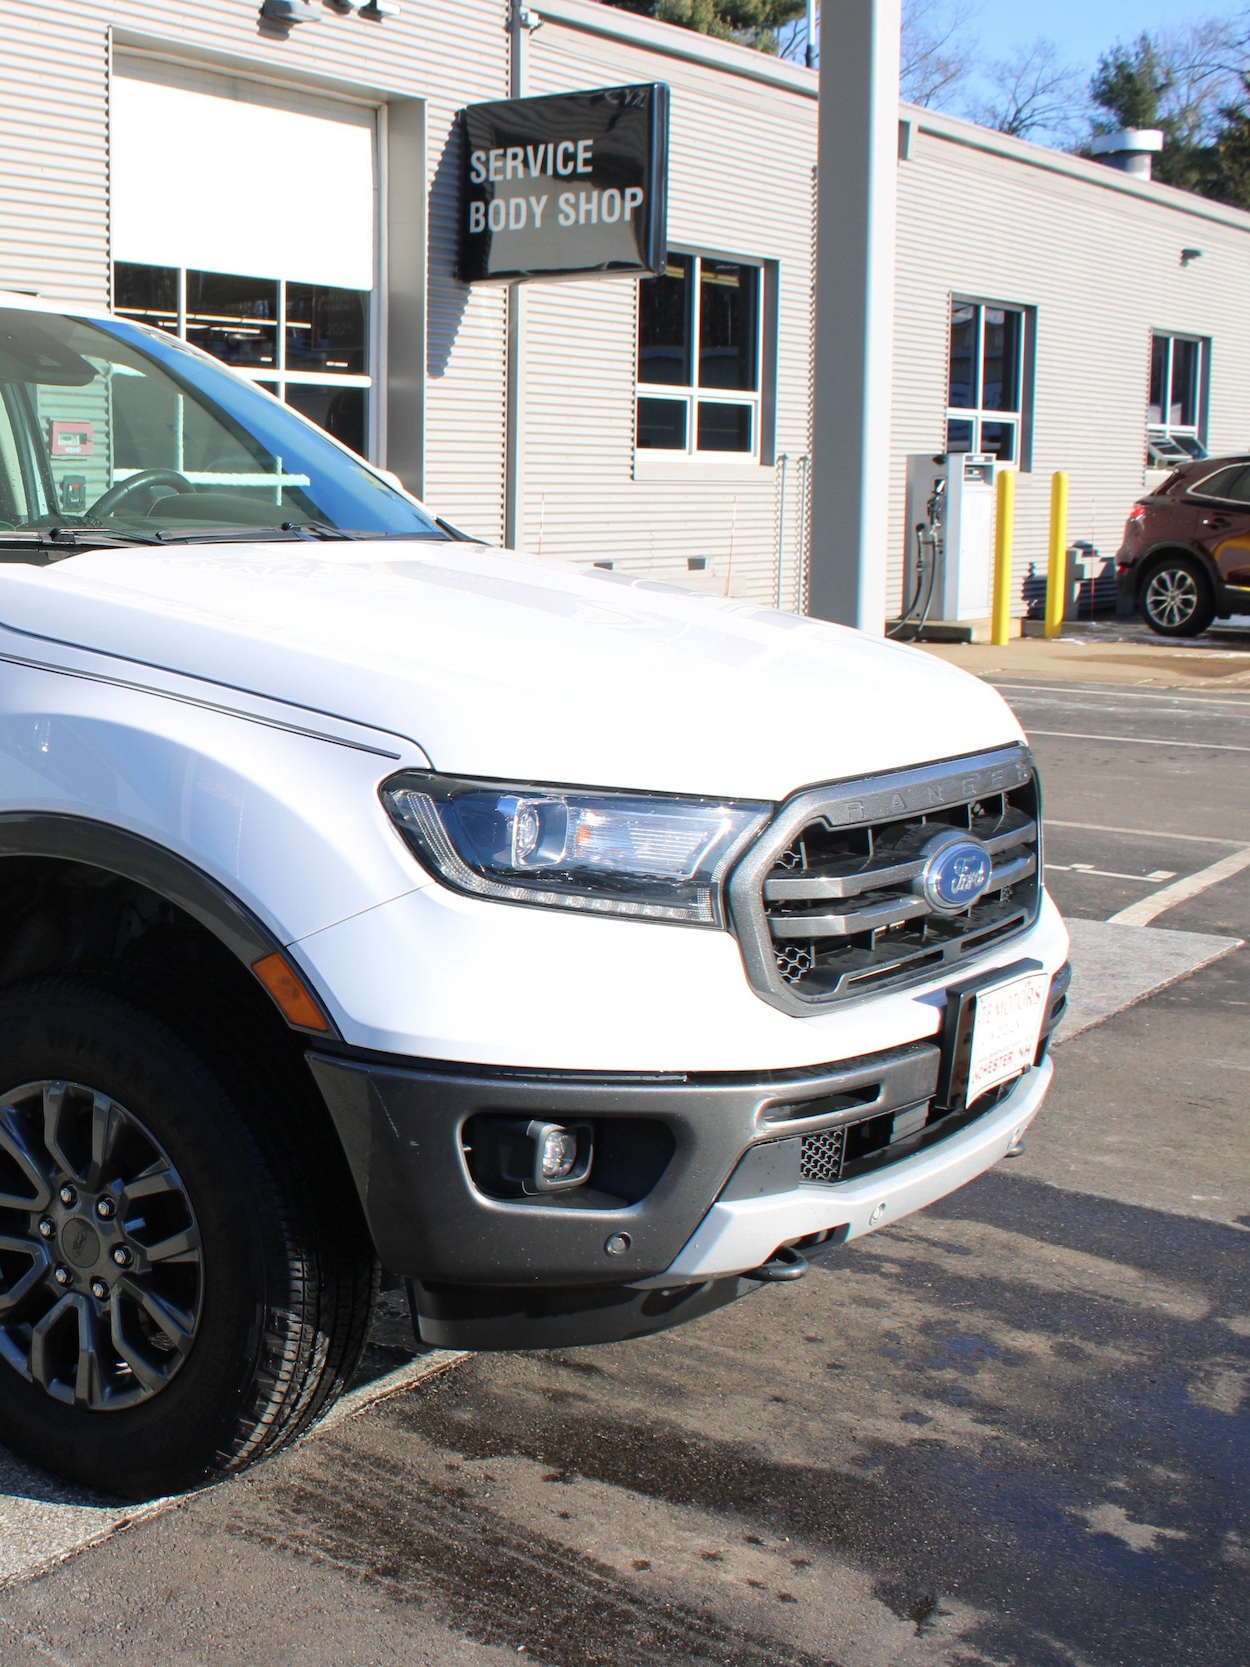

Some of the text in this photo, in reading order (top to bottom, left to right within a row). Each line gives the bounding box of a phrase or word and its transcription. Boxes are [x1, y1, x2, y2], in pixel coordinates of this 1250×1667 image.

[470, 139, 594, 184] SERVICE
[469, 187, 644, 234] BODY SHOP
[847, 760, 1028, 820] RANGER
[950, 855, 986, 894] Ford
